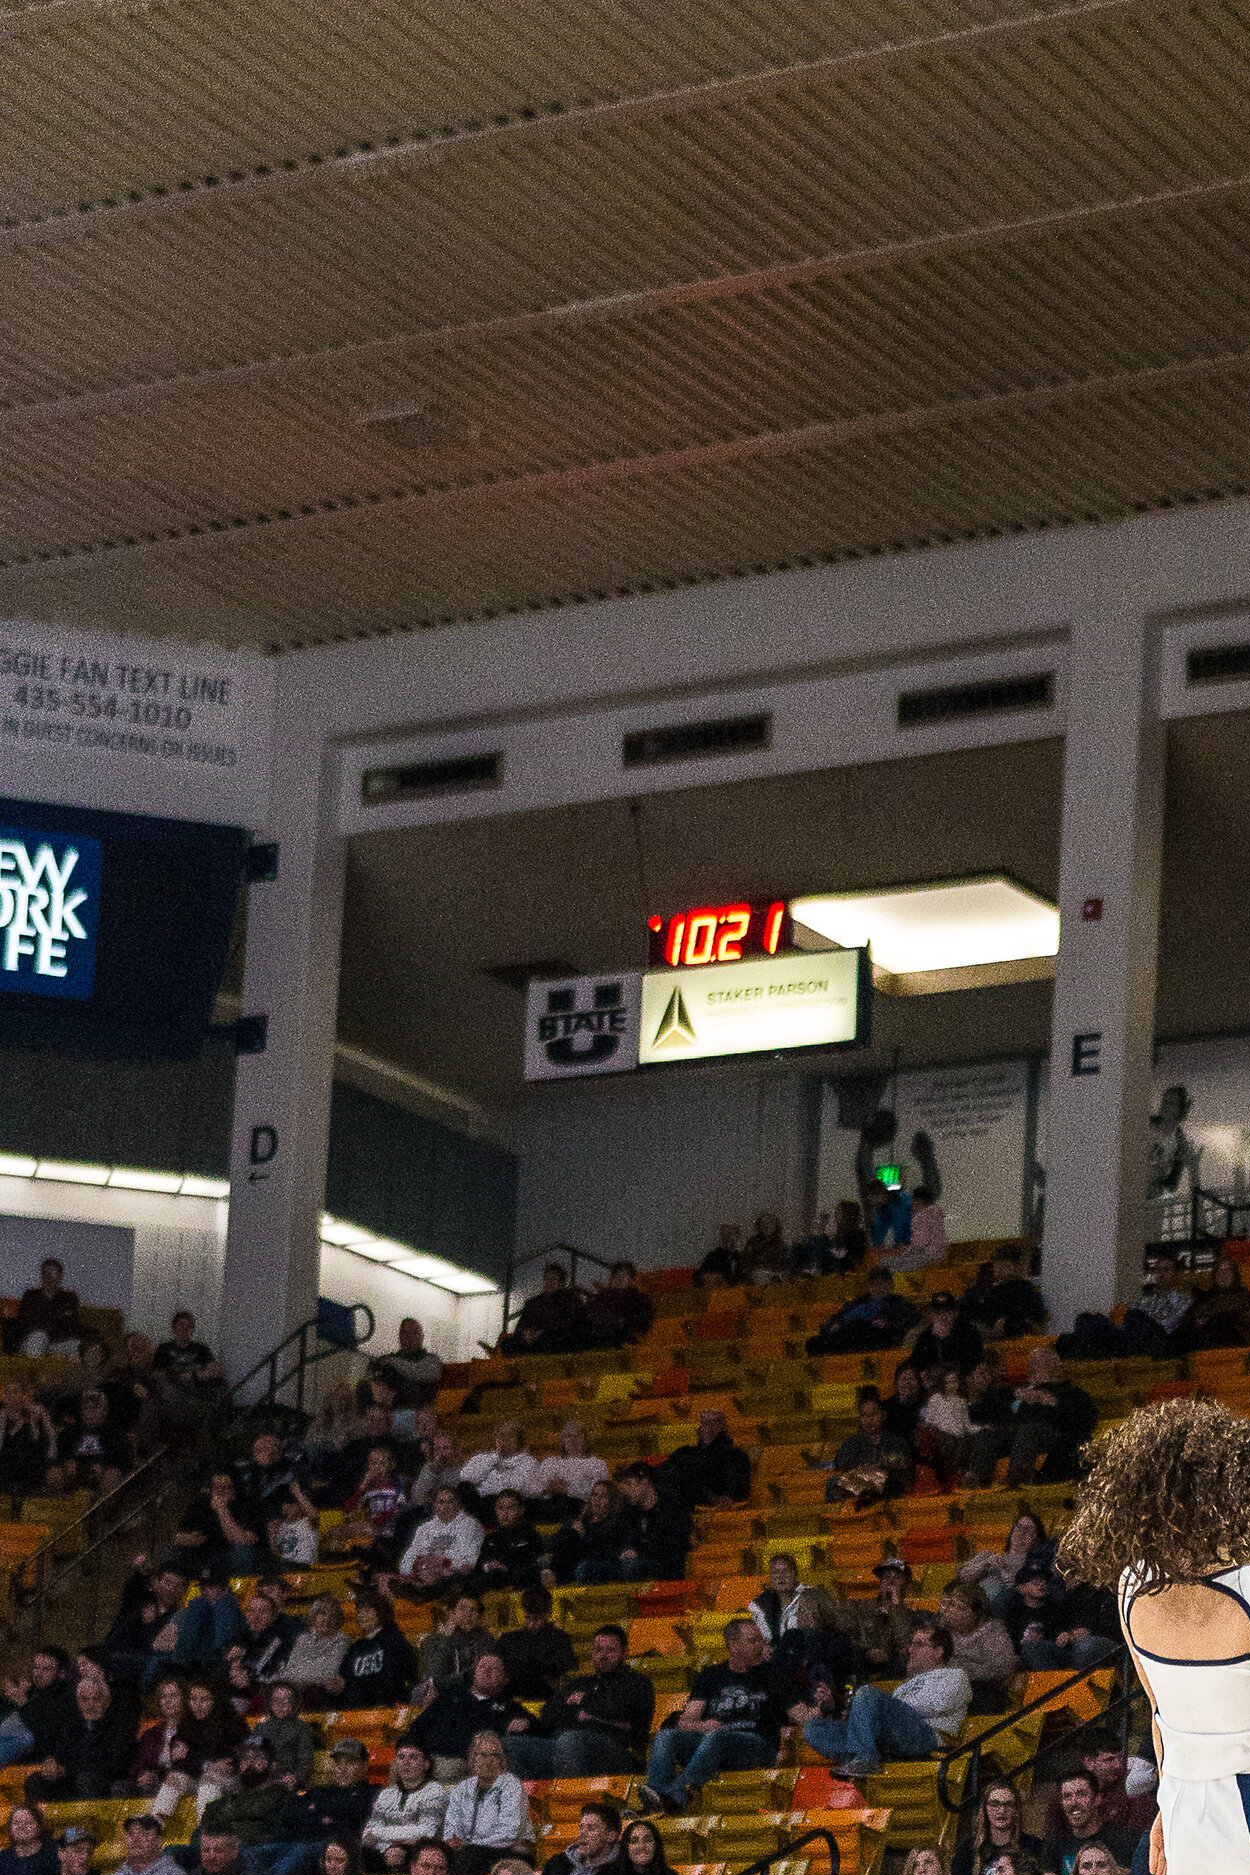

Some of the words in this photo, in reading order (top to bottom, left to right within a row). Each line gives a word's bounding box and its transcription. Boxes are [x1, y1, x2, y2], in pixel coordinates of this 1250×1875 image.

[61, 657, 108, 687] FAN
[117, 665, 172, 696] TEXT
[180, 676, 231, 705] LINE
[707, 986, 763, 1006] STAKER
[768, 979, 829, 998] PARSON
[538, 1008, 627, 1042] STATE
[1072, 1032, 1102, 1077] E
[250, 1125, 279, 1165] D
